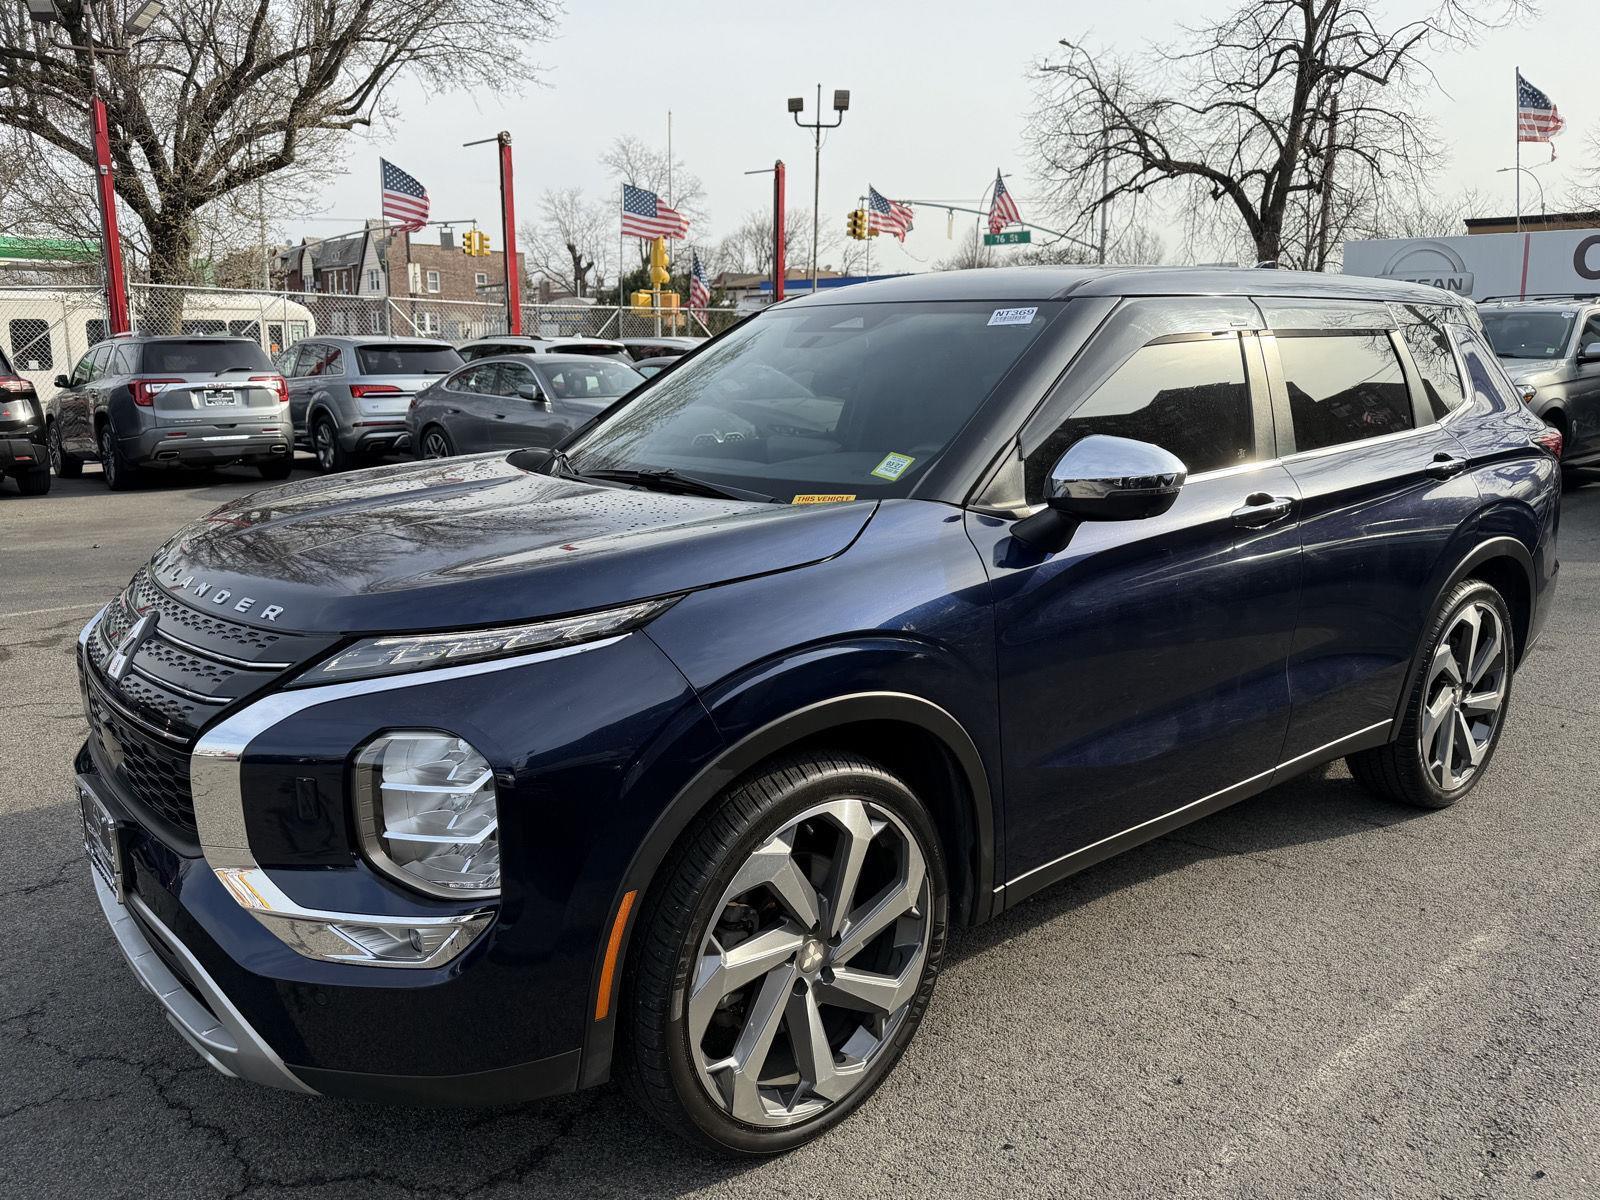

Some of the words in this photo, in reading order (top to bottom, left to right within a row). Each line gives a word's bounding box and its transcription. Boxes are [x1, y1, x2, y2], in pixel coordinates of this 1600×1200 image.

[995, 235, 1006, 243] 76
[1009, 233, 1019, 243] St
[995, 308, 1035, 317] NT369
